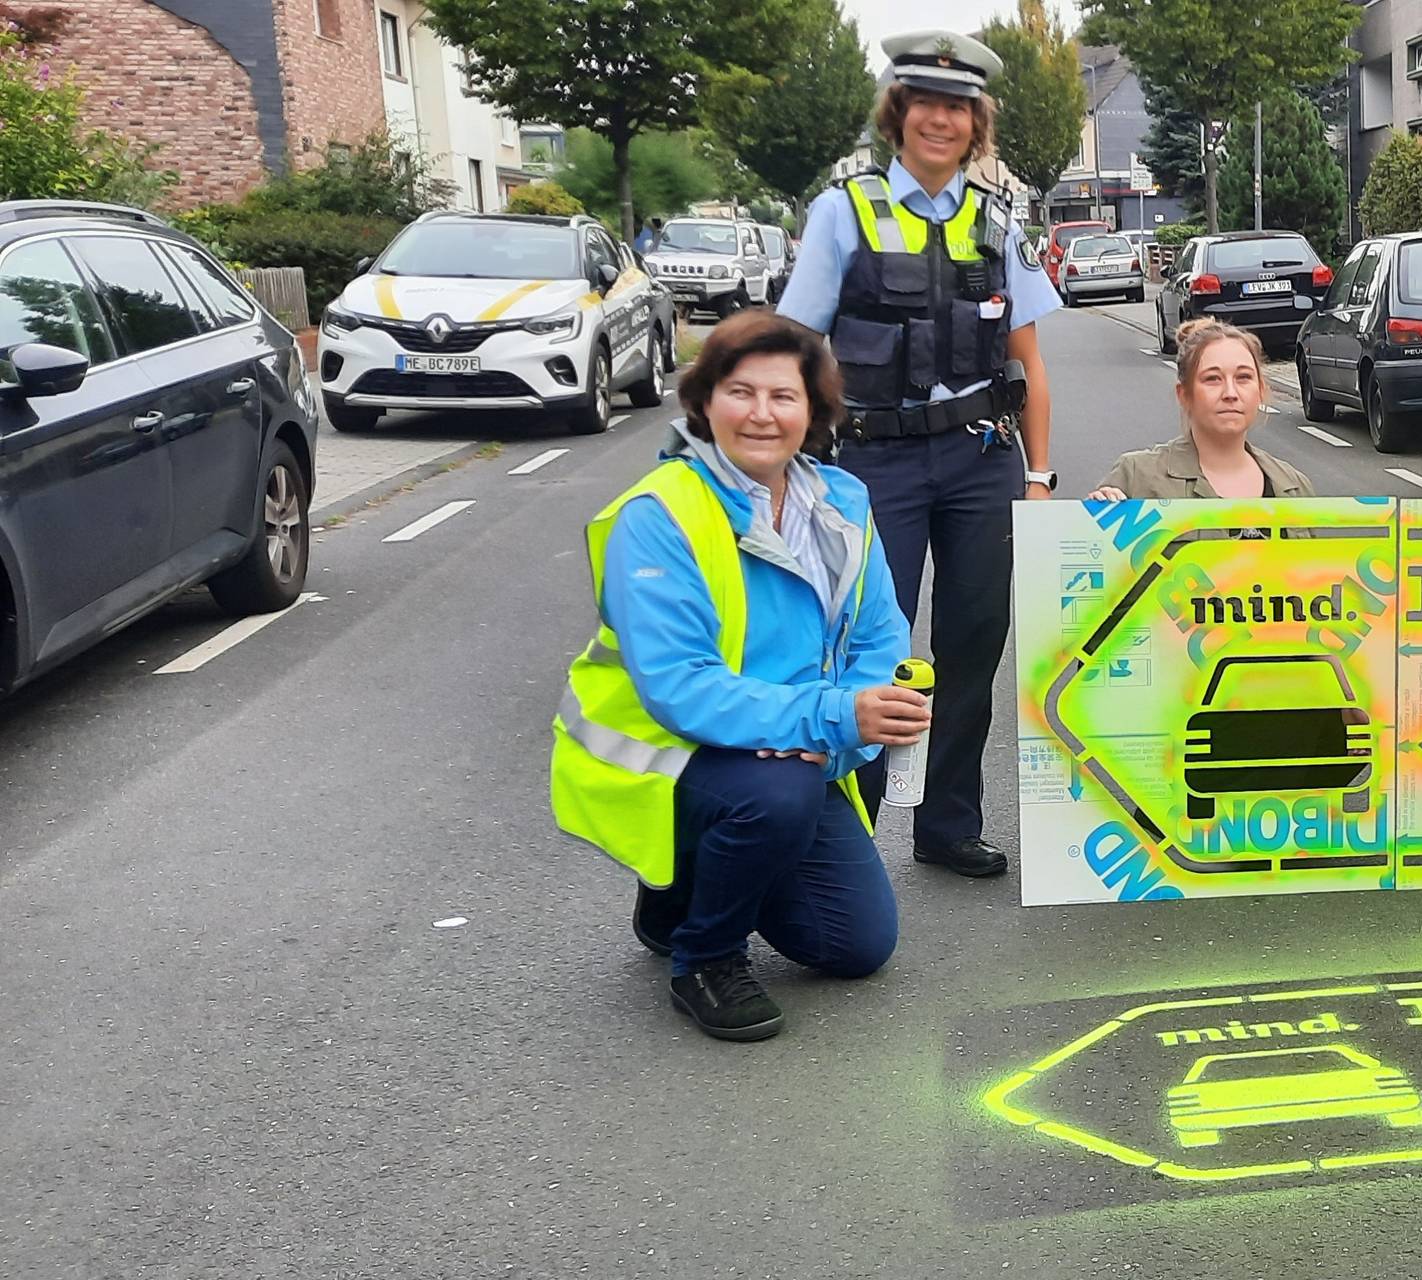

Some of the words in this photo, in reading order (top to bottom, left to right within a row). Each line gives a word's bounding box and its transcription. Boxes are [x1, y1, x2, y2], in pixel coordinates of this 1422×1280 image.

[404, 356, 421, 370] ME
[1190, 584, 1357, 624] mind.
[1156, 1013, 1362, 1046] mind.
